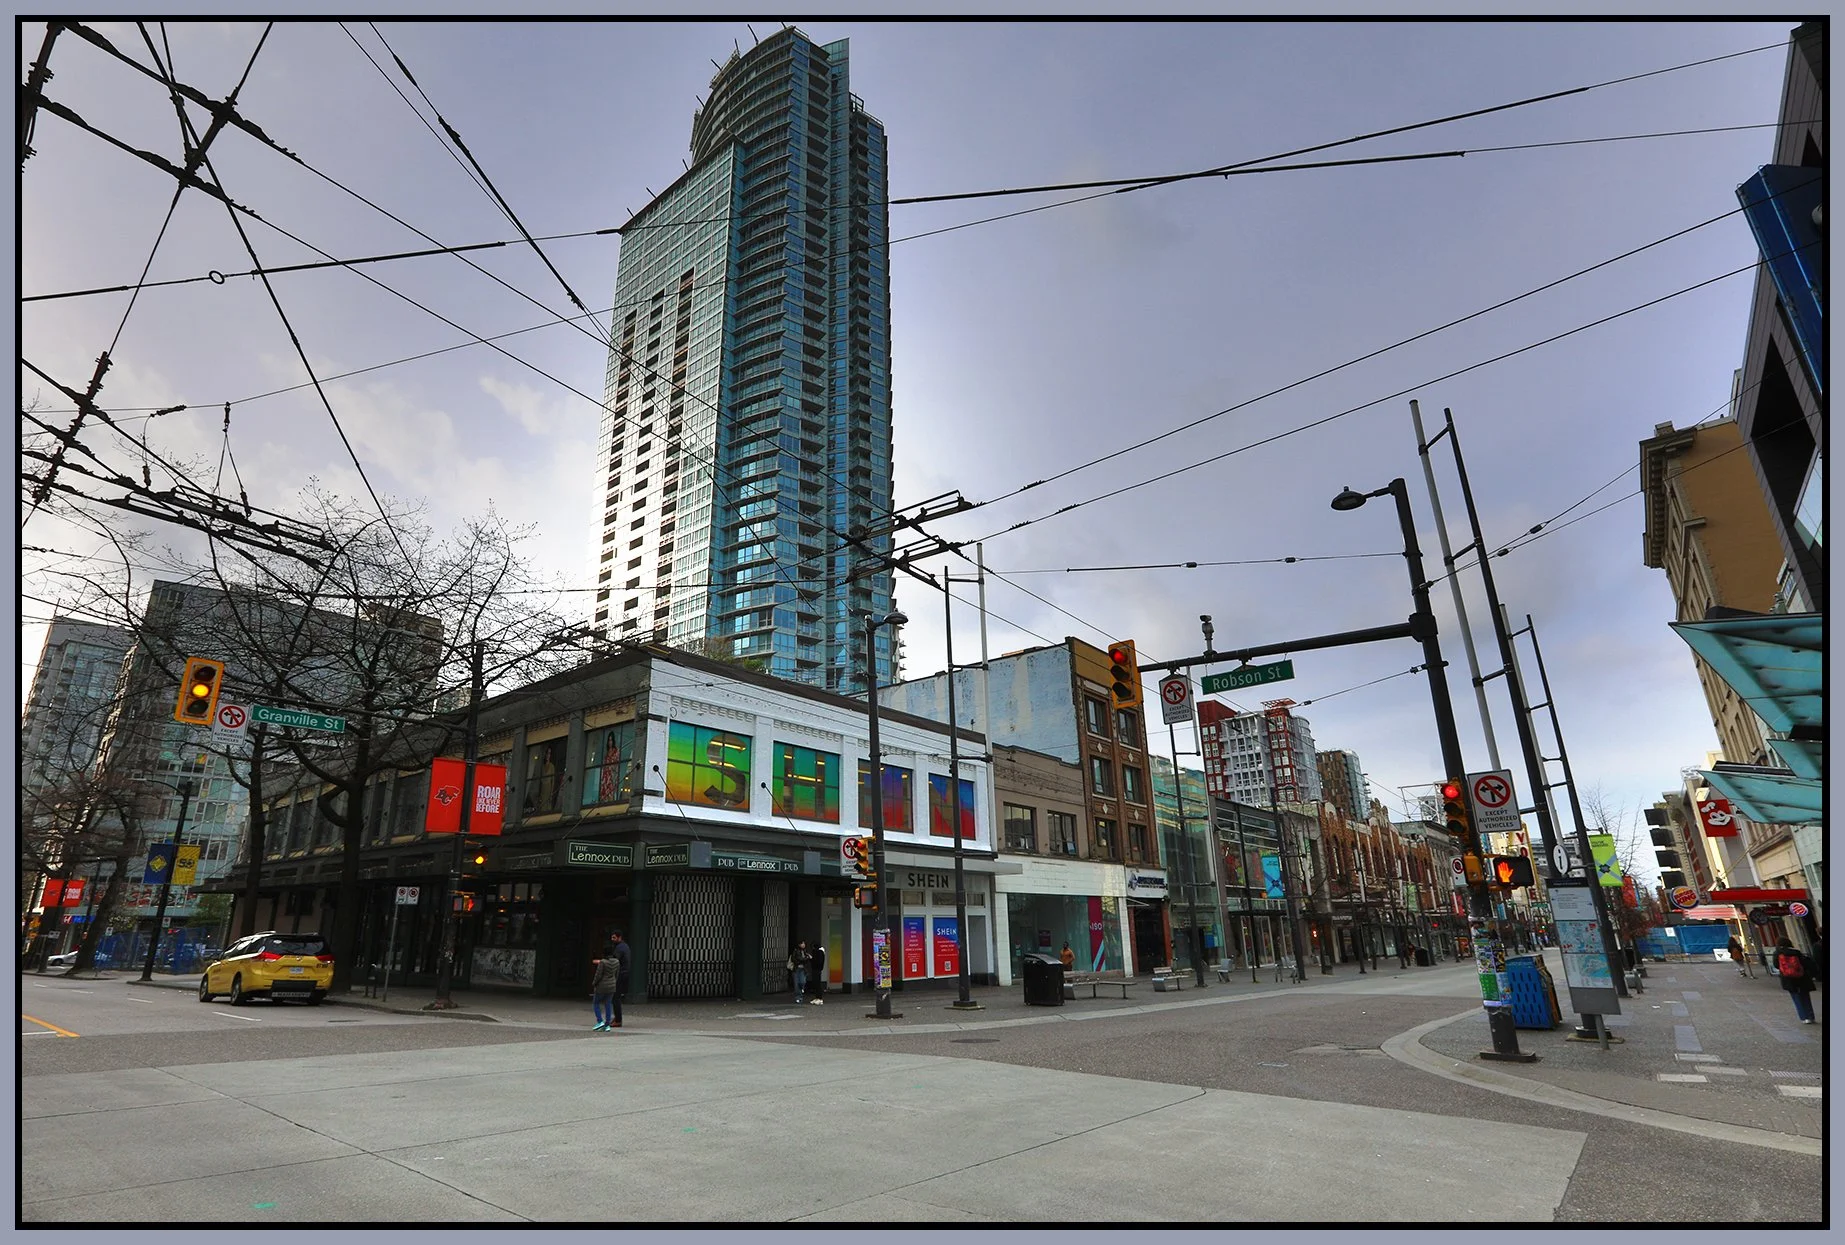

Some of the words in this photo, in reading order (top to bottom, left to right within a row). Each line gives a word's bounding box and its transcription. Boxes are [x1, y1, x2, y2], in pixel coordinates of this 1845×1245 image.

[1212, 671, 1262, 690] Robson
[1267, 665, 1281, 680] St
[258, 708, 318, 727] Granville
[324, 717, 340, 730] St
[476, 785, 501, 799] ROAR
[475, 803, 500, 813] BEFORE
[1478, 815, 1518, 823] AUTHORIZED
[1483, 821, 1514, 829] VEHICLES
[571, 851, 611, 863] Lennox
[611, 856, 630, 864] PUB
[647, 854, 674, 864] Lennox
[717, 858, 735, 867] PUB
[746, 860, 776, 870] Lennox
[783, 863, 799, 871] PUB
[907, 872, 950, 889] SHEIN
[936, 927, 957, 936] SHEIN
